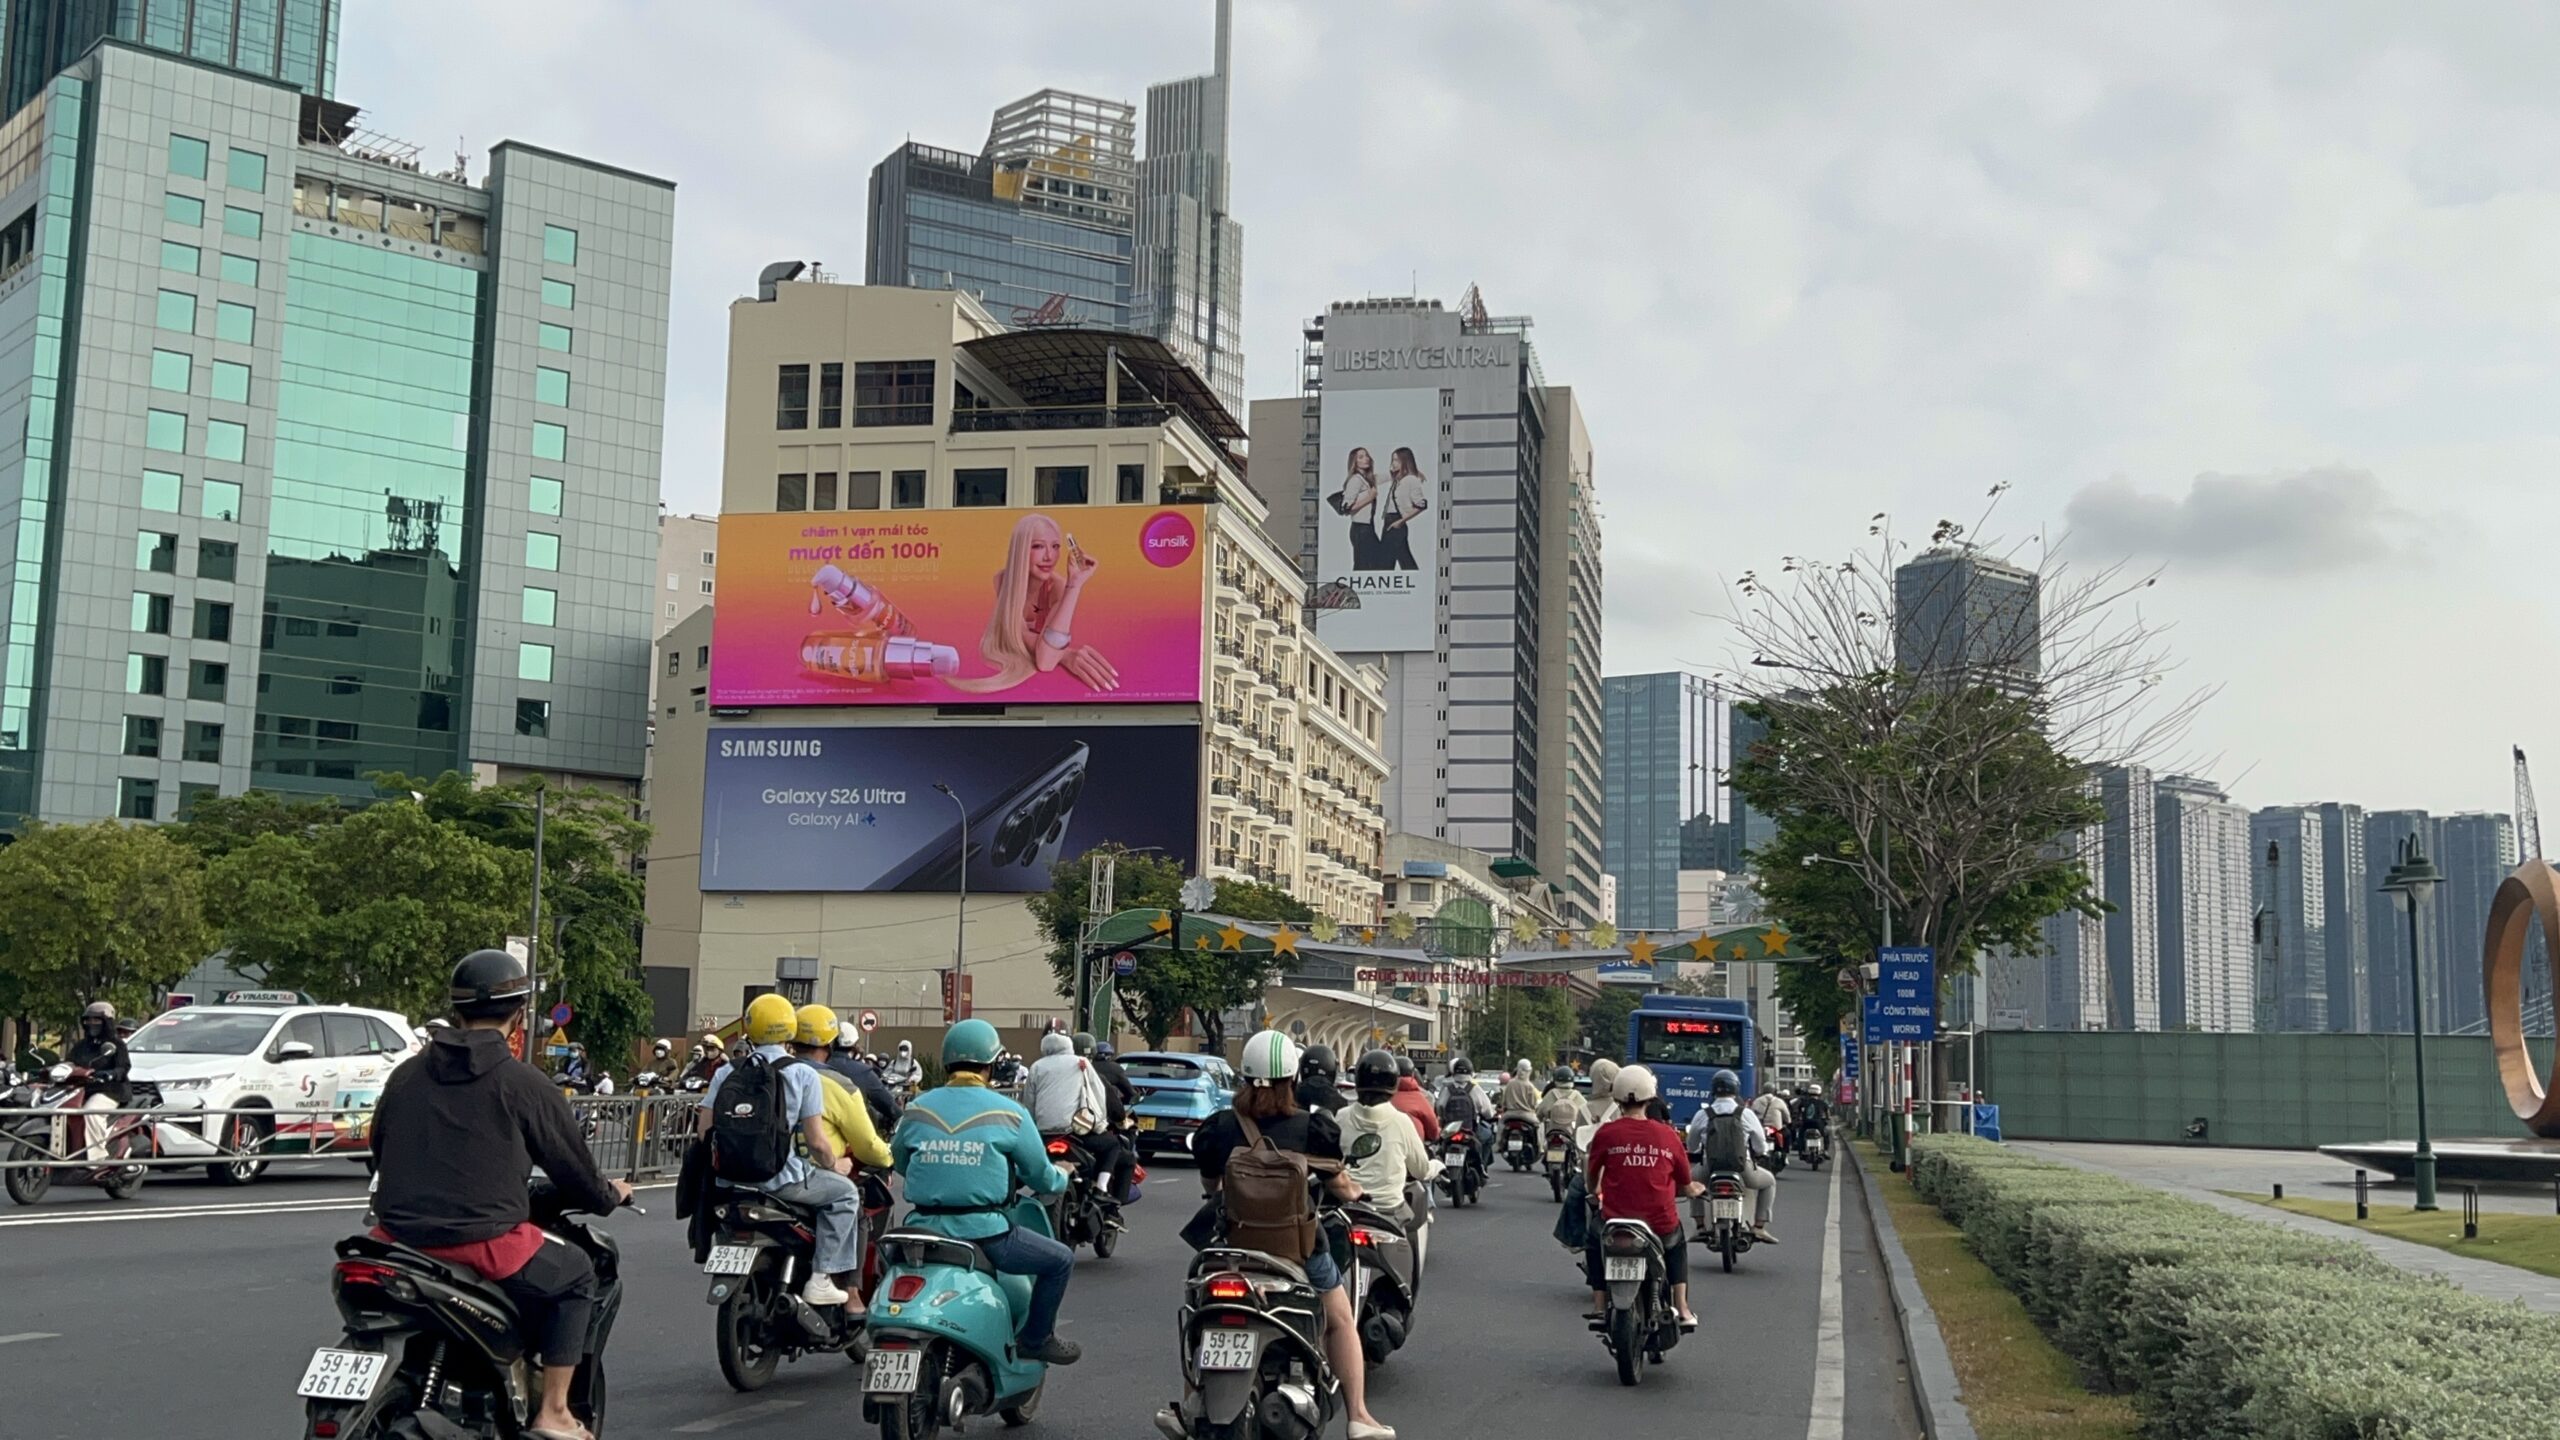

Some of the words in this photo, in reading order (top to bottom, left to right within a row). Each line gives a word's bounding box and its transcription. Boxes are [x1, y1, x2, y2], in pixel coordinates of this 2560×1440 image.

[1333, 349, 1412, 371] LIBERTY
[1415, 345, 1511, 369] CENTRAL
[842, 526, 847, 537] 1
[851, 526, 875, 539] vạn
[878, 524, 903, 536] mái
[907, 523, 929, 536] tóc
[1148, 535, 1189, 548] sunsilk
[789, 545, 842, 563] mượt
[848, 540, 885, 559] đến
[1335, 576, 1416, 590] CHANEL
[720, 739, 822, 757] SAMSUNG
[762, 788, 828, 808] Galaxy
[829, 788, 860, 804] S26
[864, 788, 906, 804] Ultra
[787, 812, 842, 829] Galaxy
[844, 813, 859, 825] AI
[1892, 971, 1919, 981] AHEAD
[243, 993, 278, 1001] VINASUN
[1897, 989, 1916, 998] 100M
[1883, 1004, 1906, 1016] CÔNG
[1907, 1004, 1930, 1016] TRÌNH
[1892, 1024, 1921, 1034] WORKS
[919, 1139, 960, 1152] XANH
[963, 1141, 985, 1155] SM
[1633, 1144, 1646, 1154] de
[1649, 1145, 1659, 1155] la
[1660, 1148, 1673, 1160] vie
[920, 1151, 939, 1163] xin
[942, 1152, 981, 1166] chào!
[1622, 1155, 1658, 1167] ADLV
[1611, 1269, 1639, 1280] 1803
[1210, 1332, 1249, 1349] 59-C2
[320, 1353, 374, 1374] 59-N3
[871, 1353, 910, 1371] 59-TA
[1202, 1350, 1252, 1367] 821.27
[304, 1374, 368, 1397] 361.64
